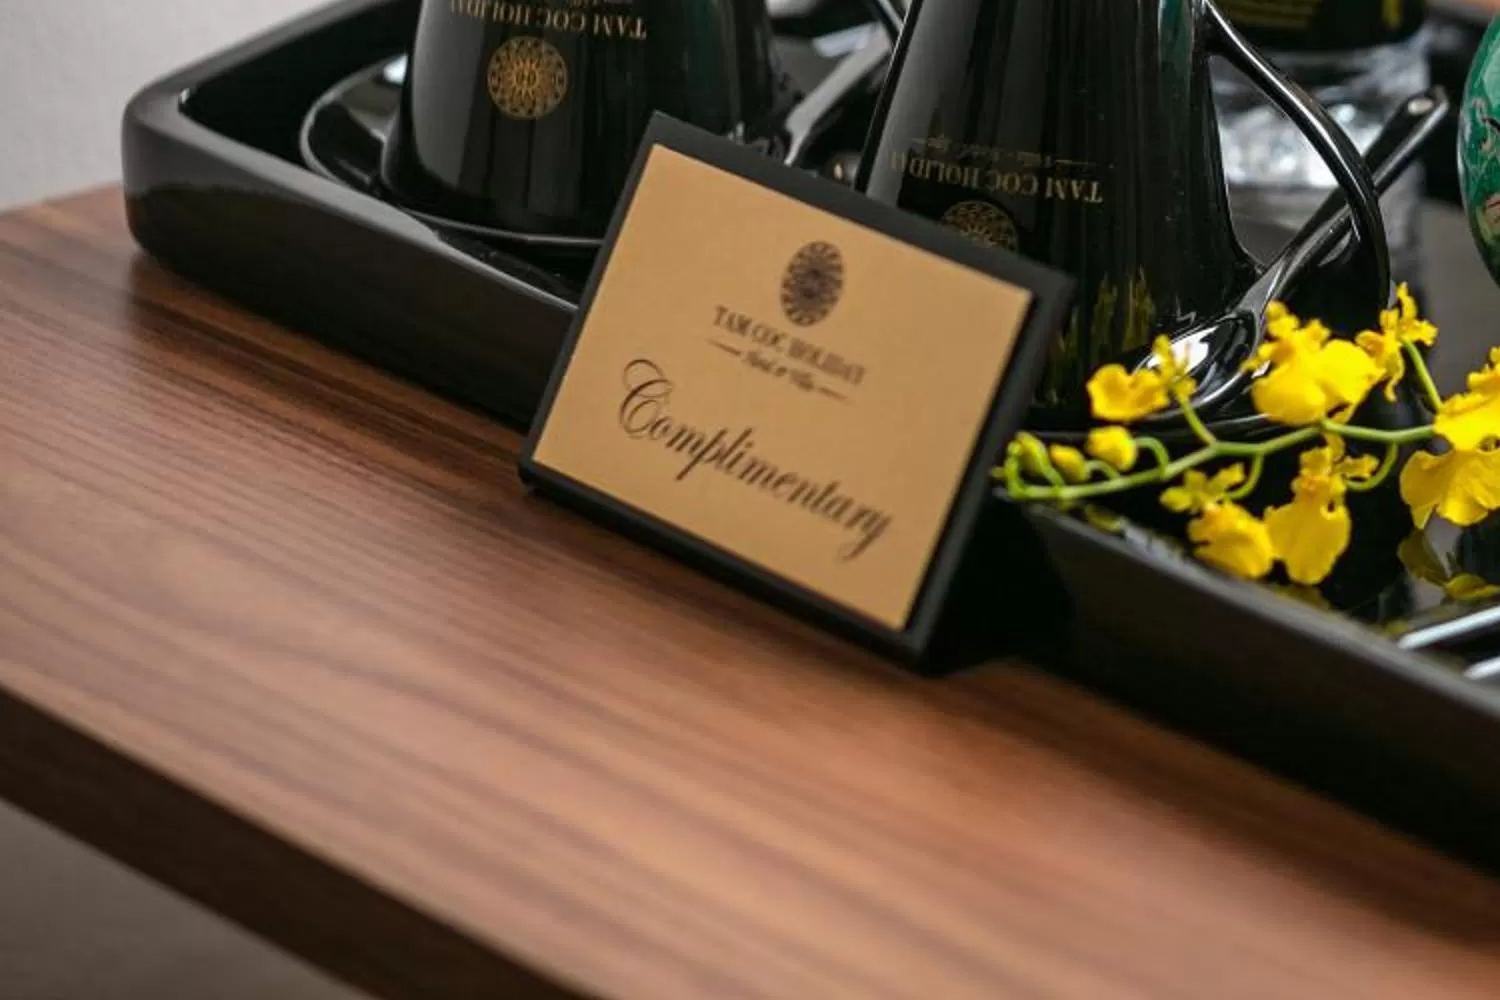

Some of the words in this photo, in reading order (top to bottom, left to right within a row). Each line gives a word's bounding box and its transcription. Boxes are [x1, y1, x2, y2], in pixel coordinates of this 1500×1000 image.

[535, 4, 587, 32] COC
[593, 14, 647, 41] TAM
[986, 169, 1040, 197] COC
[1044, 177, 1104, 204] TAM
[712, 303, 753, 338] TAM
[619, 358, 893, 564] Complimentary
